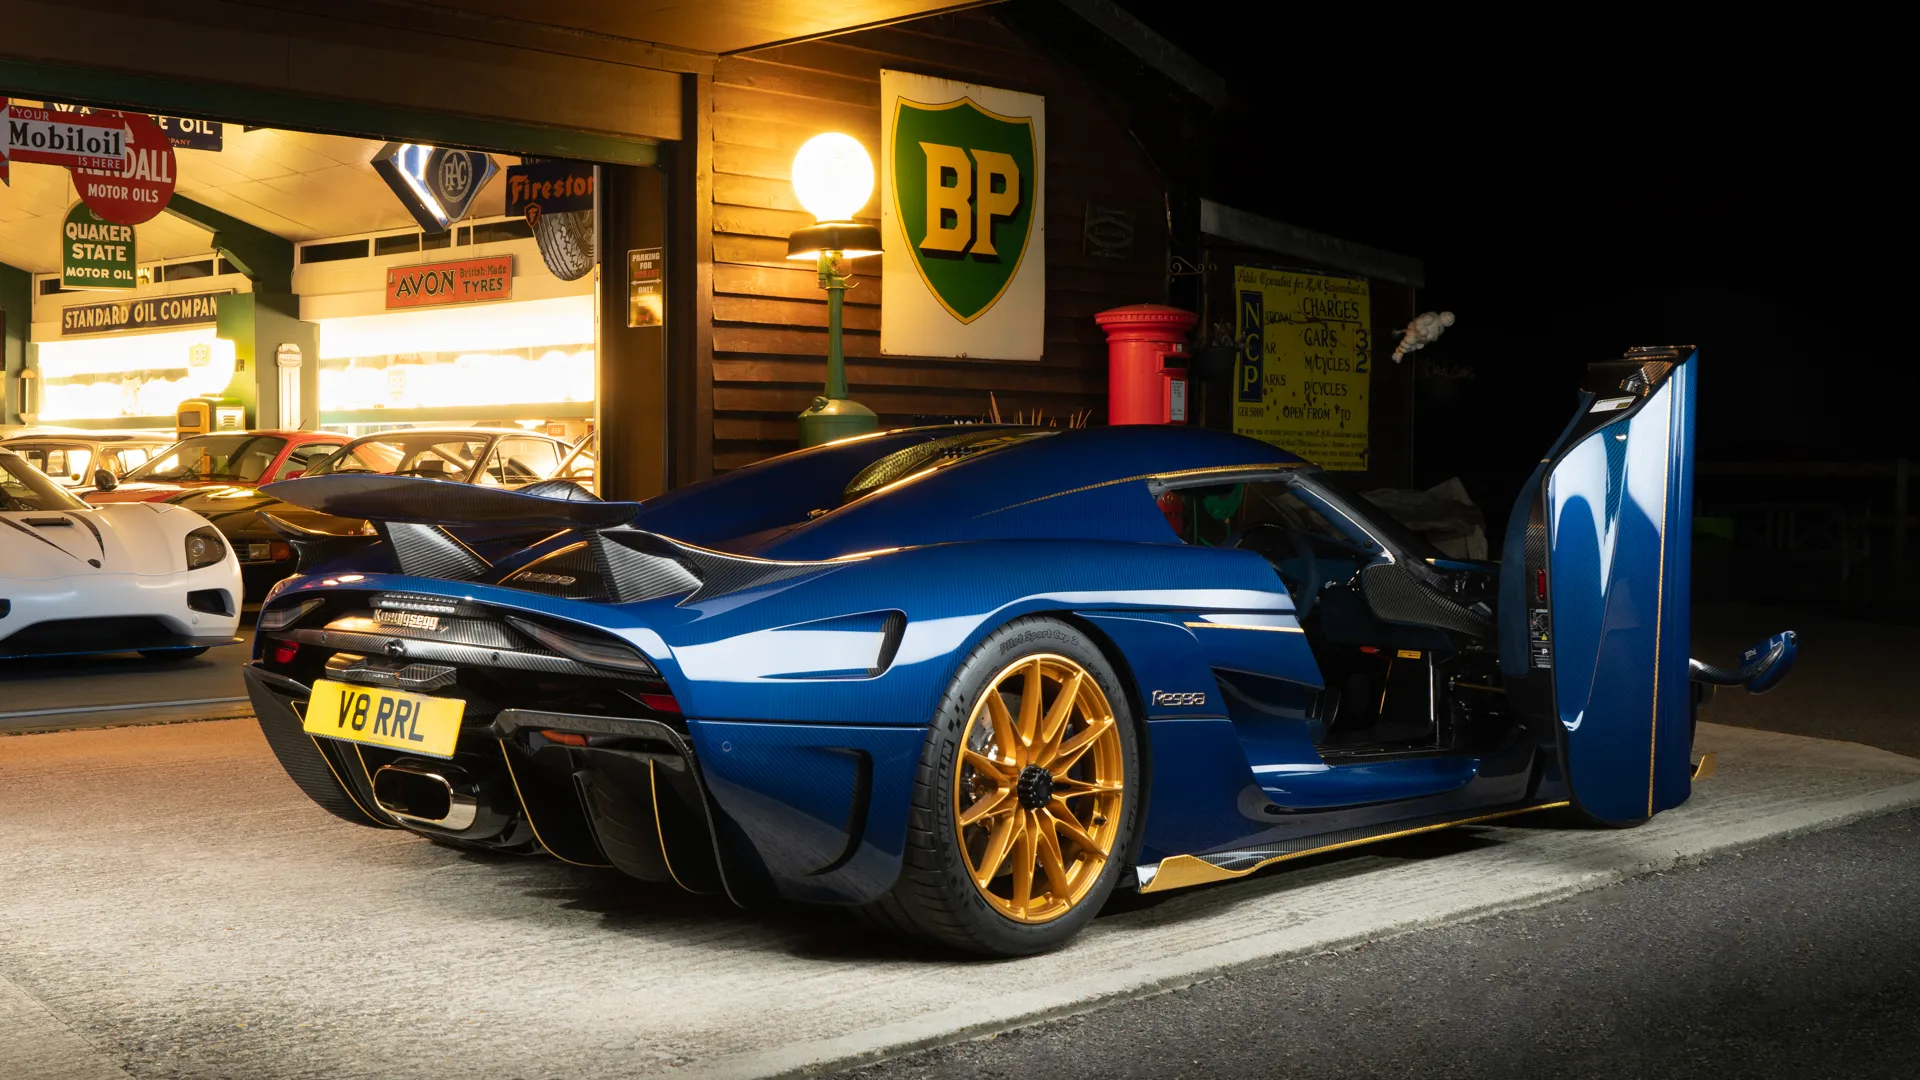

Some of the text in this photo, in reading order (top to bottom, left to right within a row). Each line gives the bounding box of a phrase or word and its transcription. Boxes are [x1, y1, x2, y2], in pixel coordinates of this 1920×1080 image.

[15, 108, 50, 121] YOUR
[179, 117, 214, 136] OIL
[8, 120, 122, 156] Mobiloil
[168, 138, 192, 146] PANY
[77, 156, 121, 170] IS HERE
[77, 147, 172, 184] DALL
[444, 153, 467, 191] RAC
[88, 183, 159, 203] MOTOR OILS
[918, 141, 1020, 256] BP
[66, 222, 131, 243] QUAKER
[72, 243, 127, 262] STATE
[632, 252, 660, 263] PARKING
[66, 266, 134, 280] MOTOR OIL
[640, 262, 653, 270] FOR
[394, 269, 456, 300] AVON
[462, 277, 503, 294] TYRES
[638, 285, 654, 294] ONLY
[64, 296, 217, 329] STANDARD OIL COMPAN
[1302, 297, 1360, 321] CHARGES
[1304, 327, 1369, 351] CARS 3
[1355, 351, 1369, 373] 2
[1249, 407, 1264, 418] 5000
[1282, 405, 1351, 421] OPEN FROM TO
[999, 629, 1080, 656] Pilot Sport Cup 2
[337, 689, 425, 743] V8 RRL
